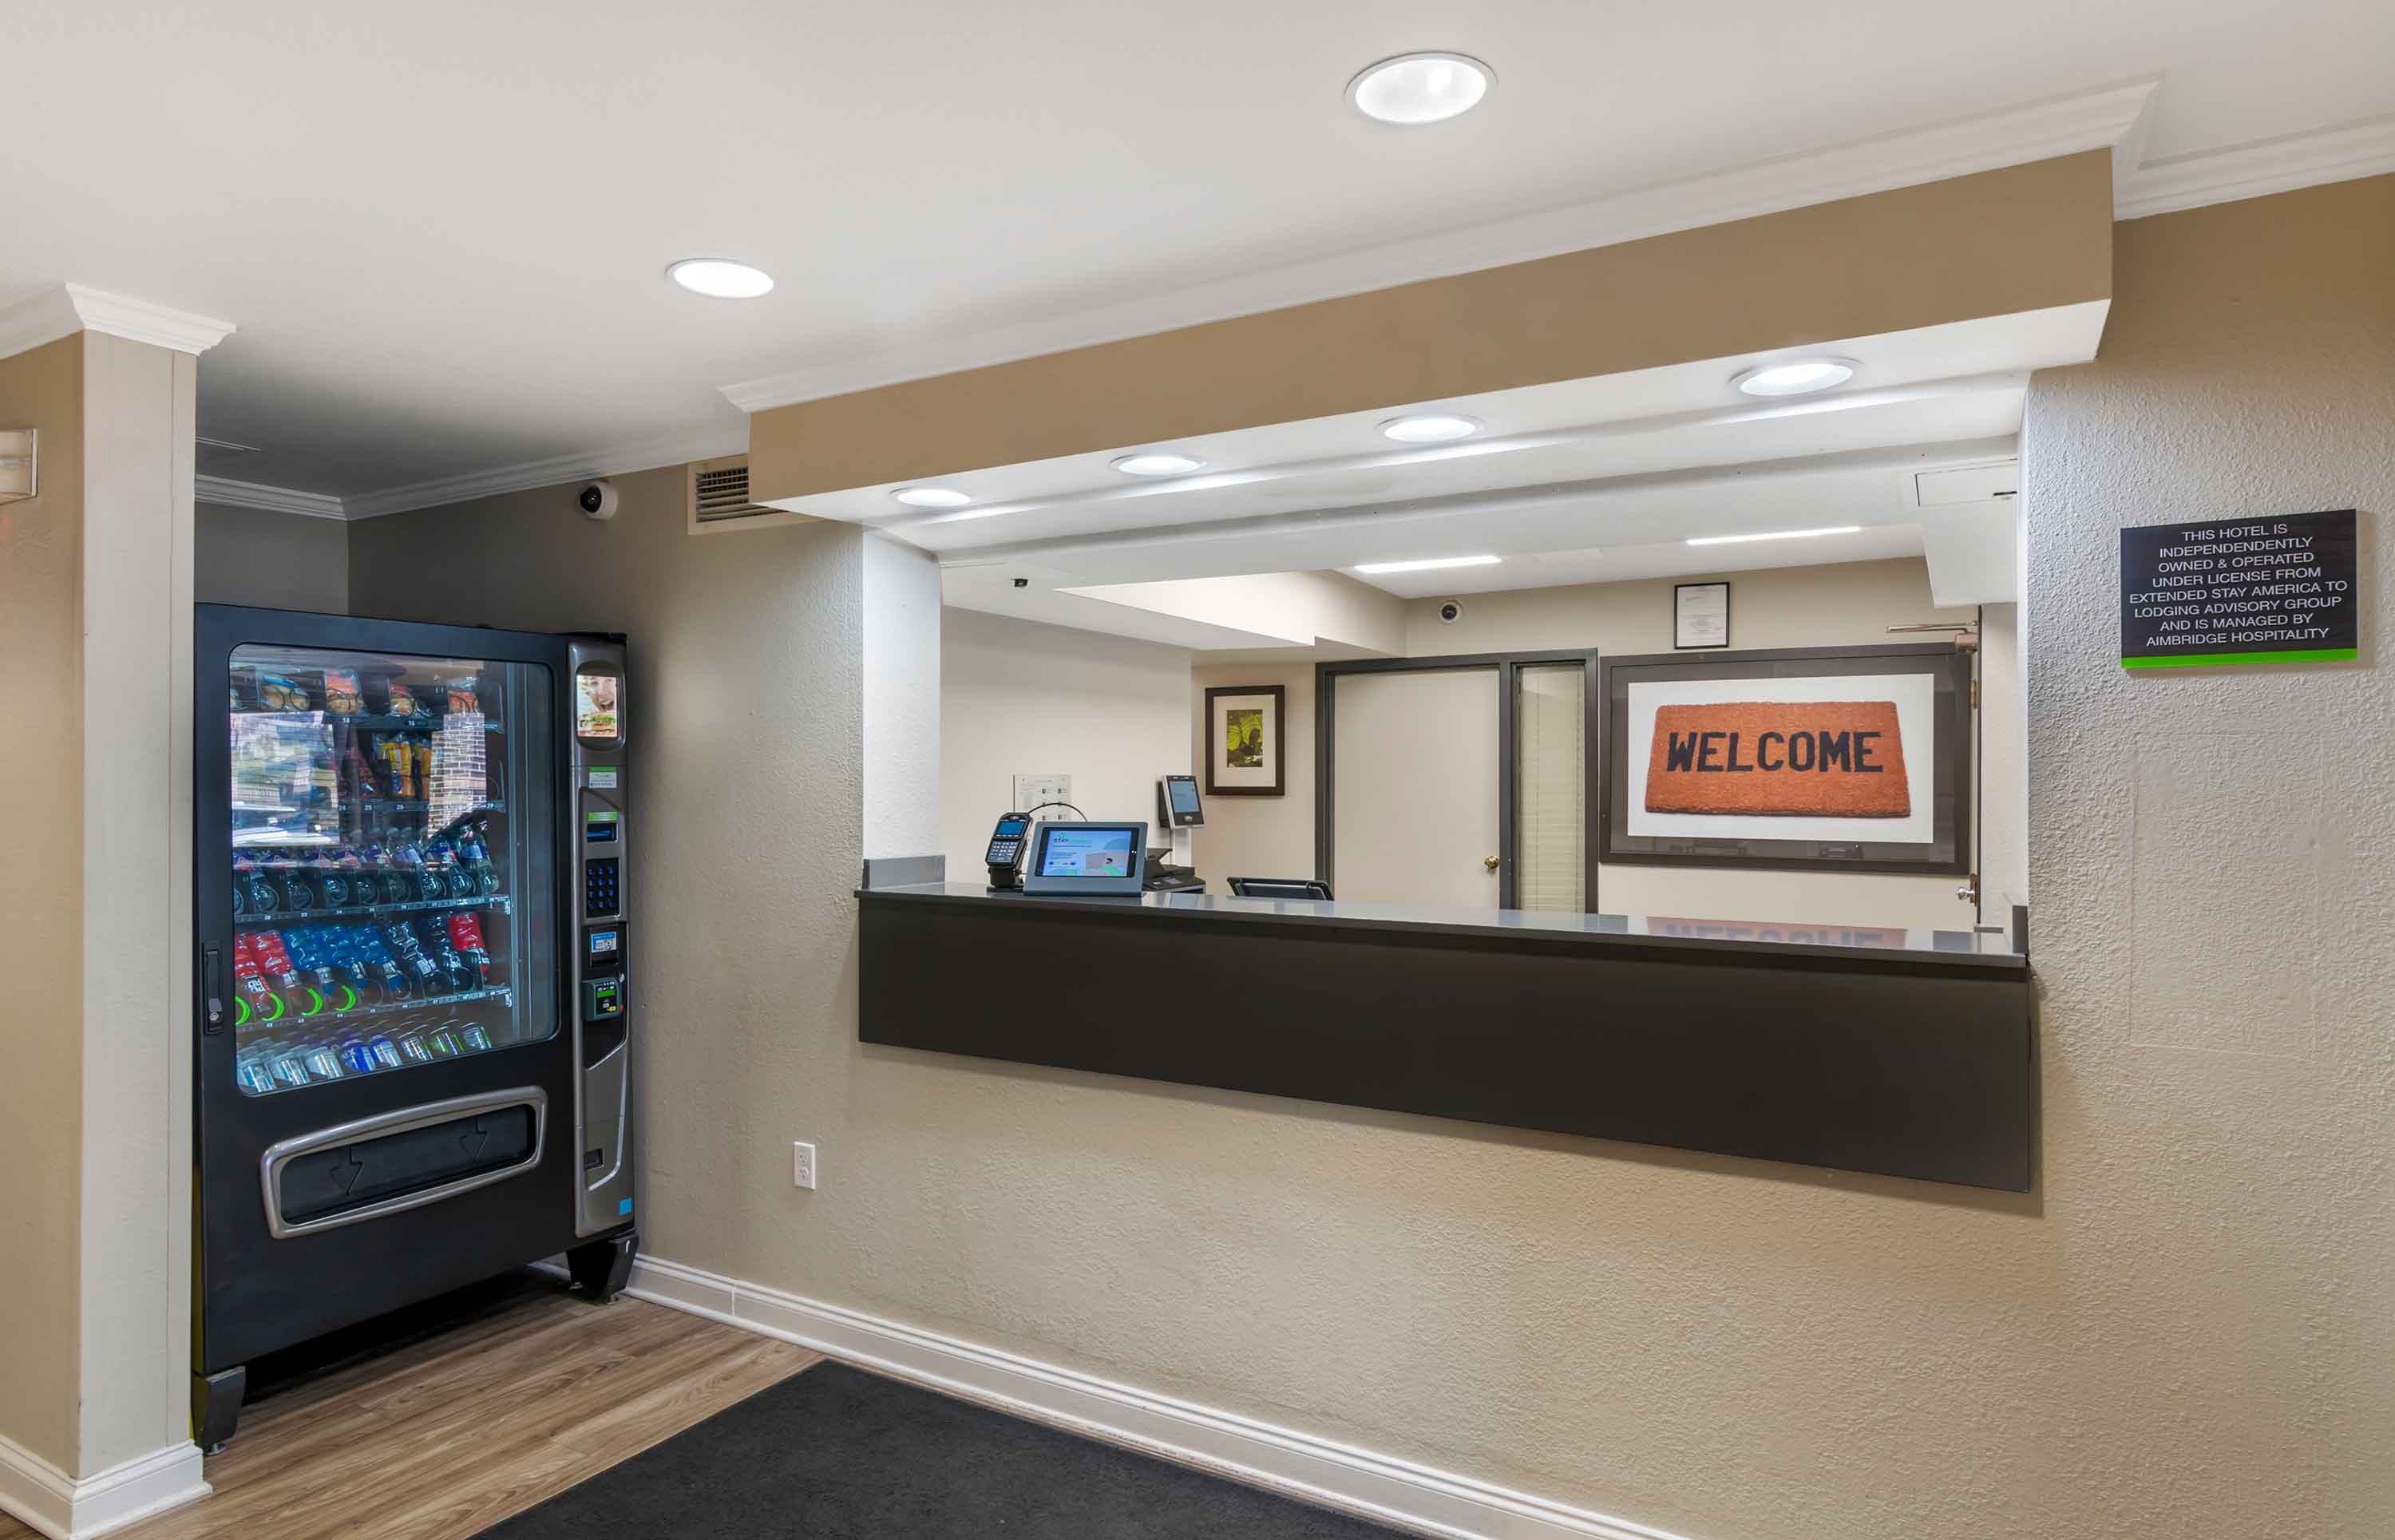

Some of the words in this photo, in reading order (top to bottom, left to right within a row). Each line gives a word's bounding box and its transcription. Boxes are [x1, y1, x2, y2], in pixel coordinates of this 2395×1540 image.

[2182, 531, 2215, 541] THIS
[2220, 526, 2268, 538] HOTEL
[2274, 524, 2286, 534] IS
[2159, 537, 2312, 557] INDEPENDENDENTLY
[2159, 560, 2213, 572] OWNED
[2219, 559, 2227, 568] &
[2232, 552, 2314, 567] OPERATED
[2153, 576, 2203, 588] UNDER
[2208, 571, 2270, 584] LICENSE
[2276, 564, 2321, 580] FROM
[2130, 590, 2207, 604] EXTENDED
[2211, 588, 2247, 599] STAY
[2252, 582, 2321, 596] AMERICA
[2326, 580, 2347, 592] TO
[2135, 605, 2199, 618] LODGING
[2204, 600, 2280, 613] ADVISORY
[2285, 596, 2342, 609] GROUP
[2160, 620, 2190, 631] AND
[2195, 620, 2208, 629] IS
[2213, 615, 2287, 627] MANAGED
[2294, 613, 2313, 624] BY
[2147, 633, 2227, 647] AIMBRIDGE
[2232, 627, 2330, 642] HOSPITALITY
[1666, 730, 1884, 773] WELCOME
